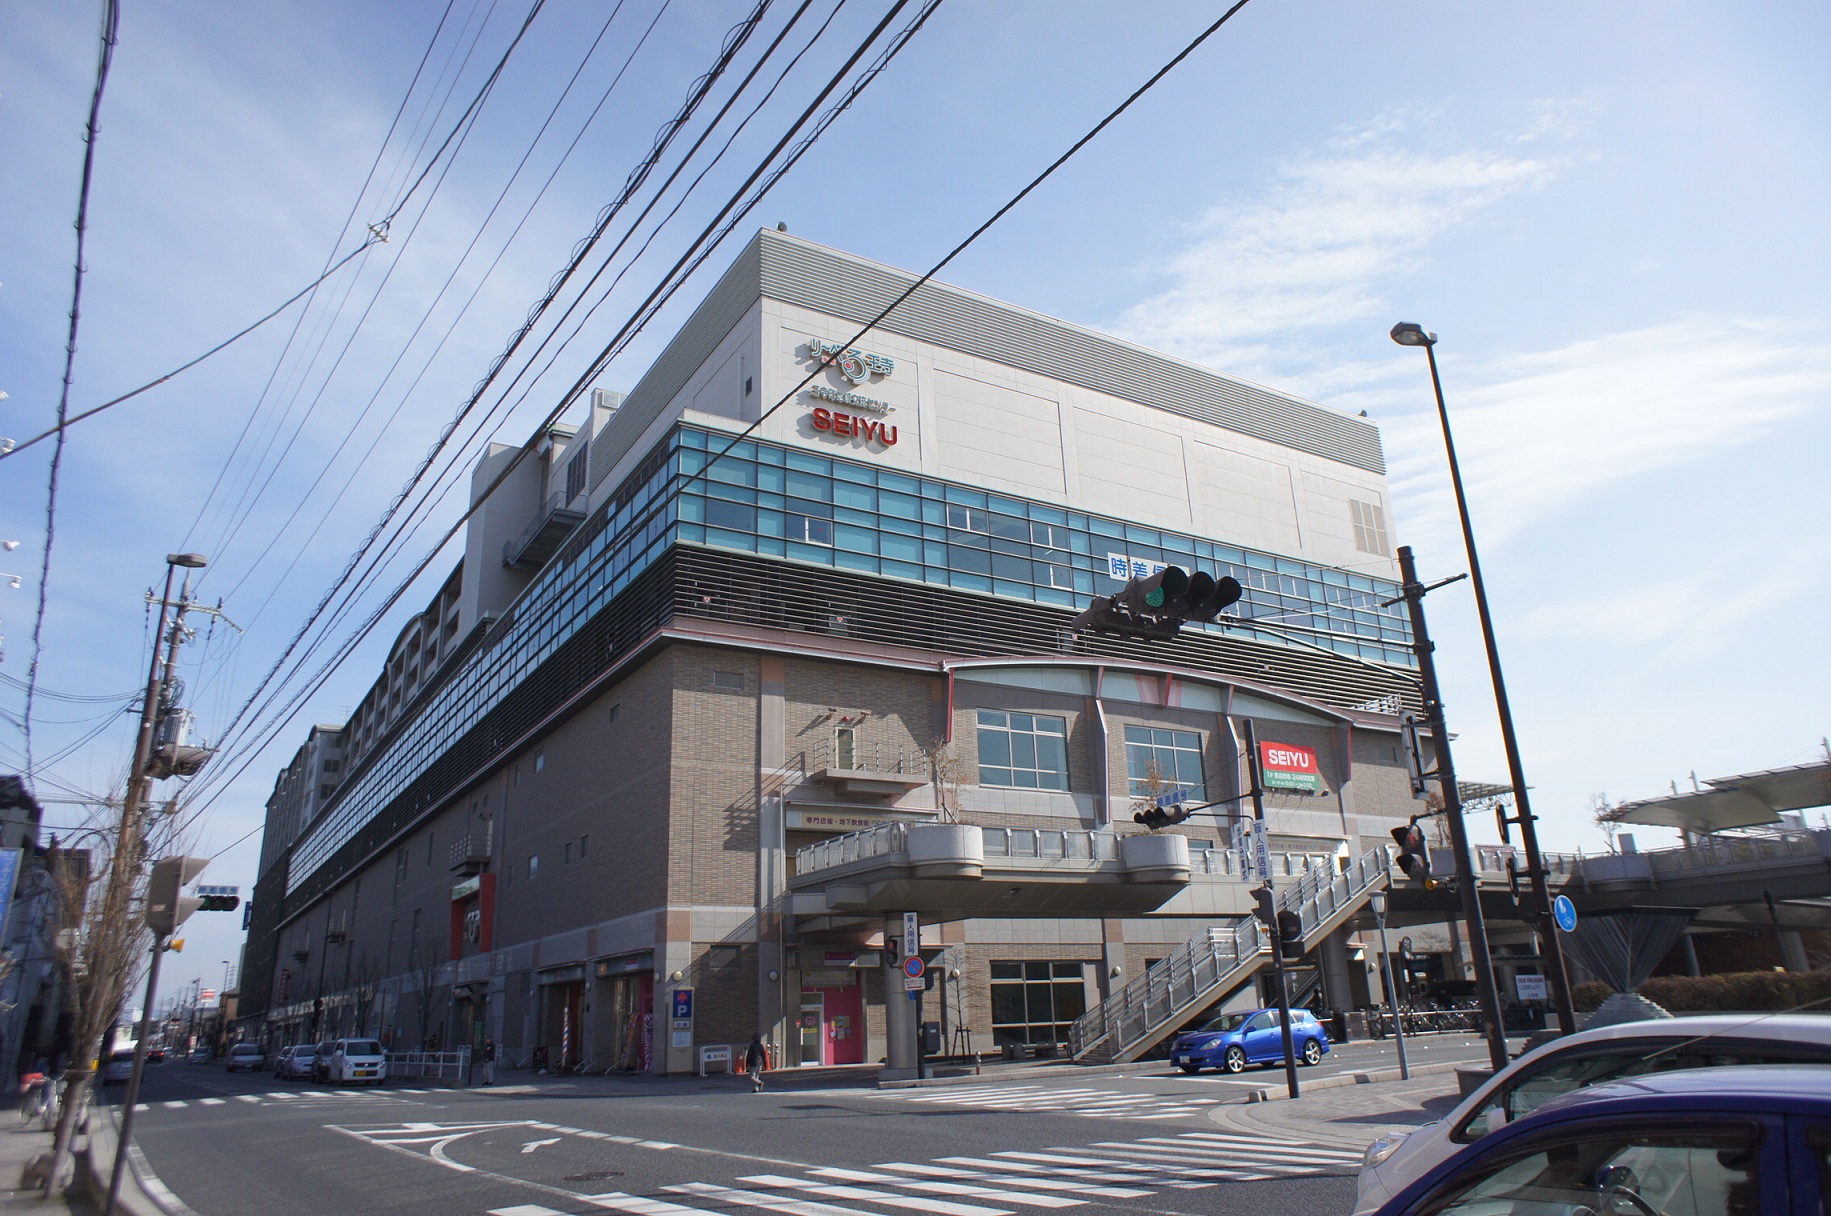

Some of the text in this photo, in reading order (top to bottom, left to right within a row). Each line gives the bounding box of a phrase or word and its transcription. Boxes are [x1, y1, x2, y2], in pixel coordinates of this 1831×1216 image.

[812, 407, 898, 446] SEIYU
[1111, 557, 1166, 577] 時差信
[1268, 749, 1309, 768] SEIYU
[1253, 822, 1267, 879] 盲人用信号
[906, 914, 915, 954] 盲人用信号
[677, 1005, 687, 1017] P
